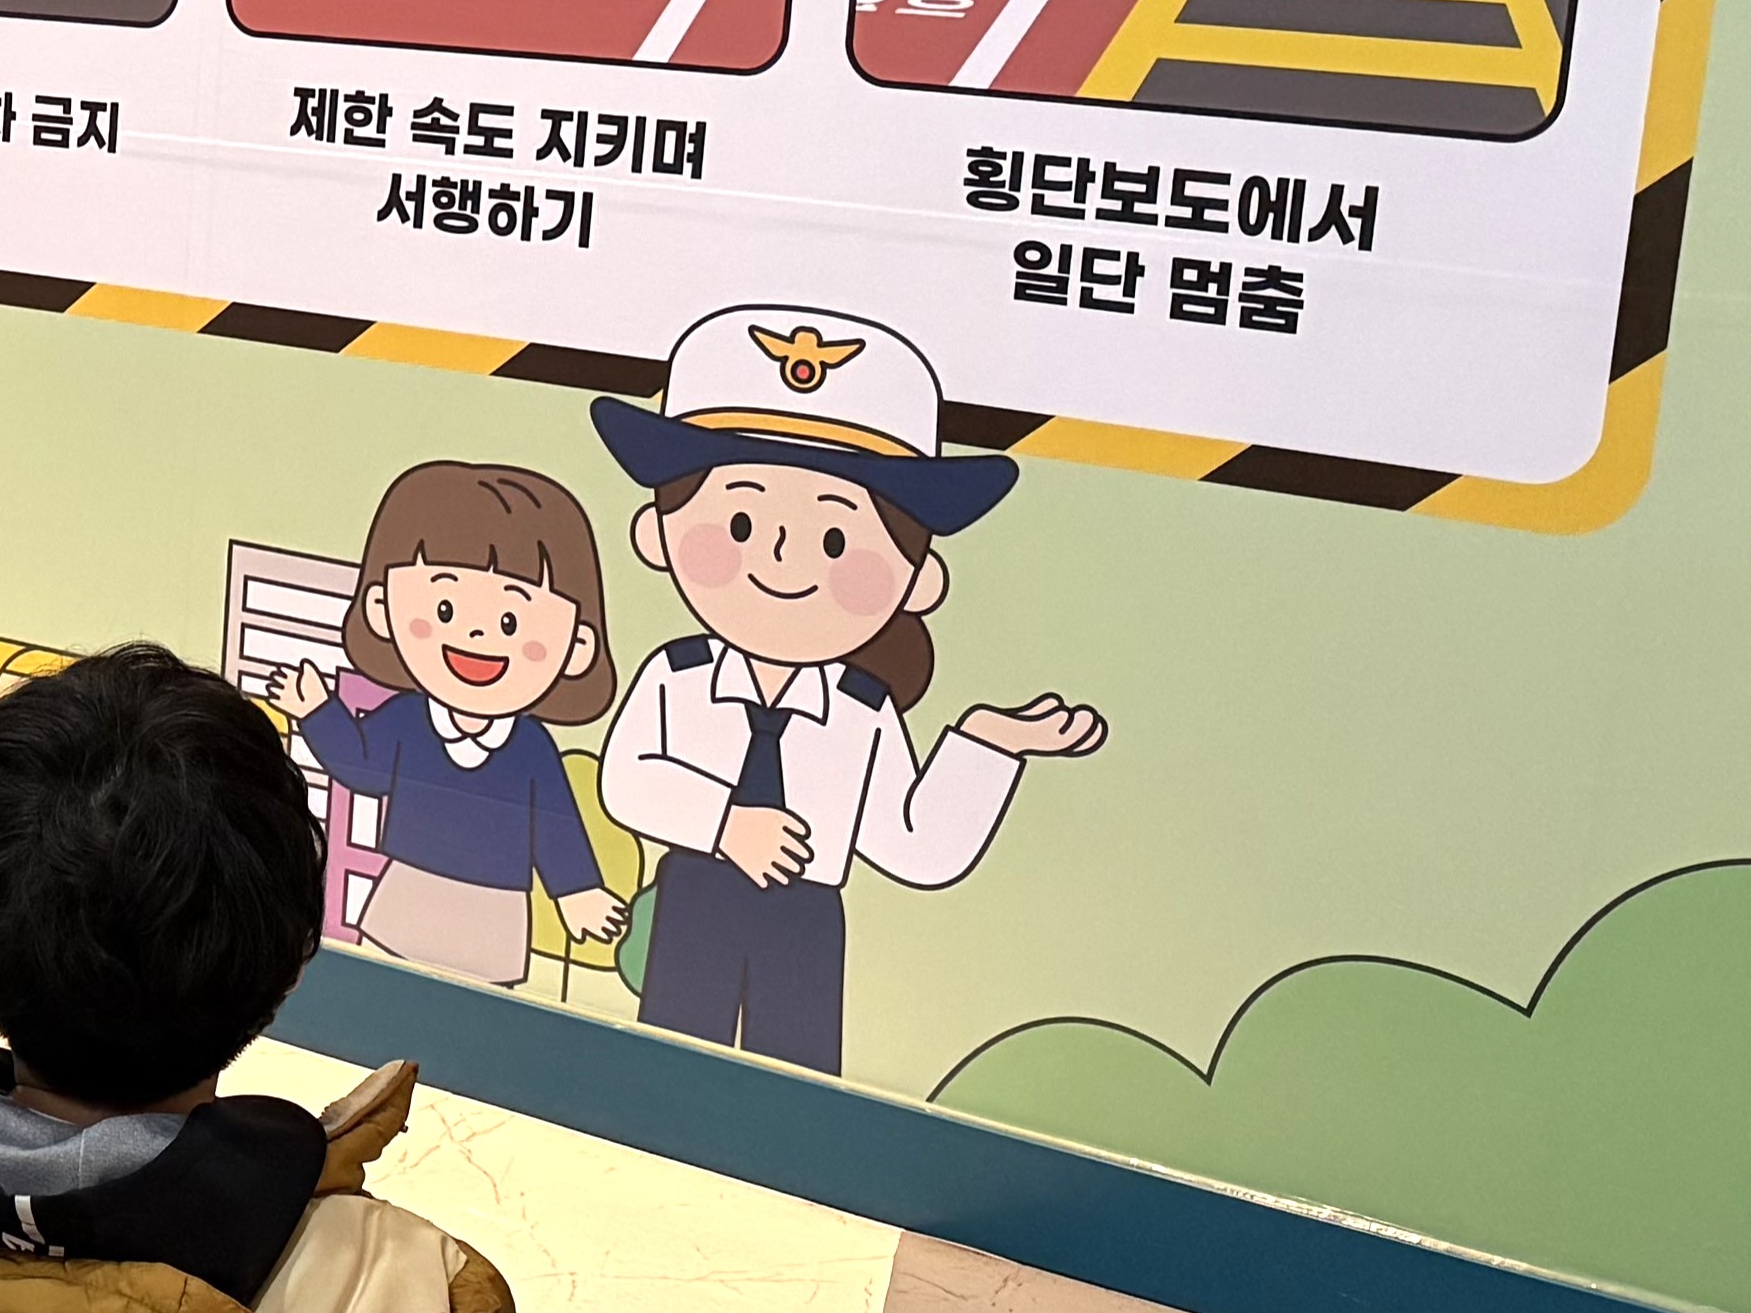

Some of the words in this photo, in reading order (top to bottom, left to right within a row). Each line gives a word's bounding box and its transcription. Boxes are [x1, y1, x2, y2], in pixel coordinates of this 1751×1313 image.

[30, 94, 121, 154] 금지
[289, 85, 393, 150] 제한
[408, 96, 516, 161] 속도
[535, 106, 708, 181] 지키며
[375, 172, 596, 249] 서행하기
[962, 145, 1380, 253] 횡단보도에서
[1012, 240, 1146, 315] 일단
[1168, 256, 1305, 335] 멈춤
